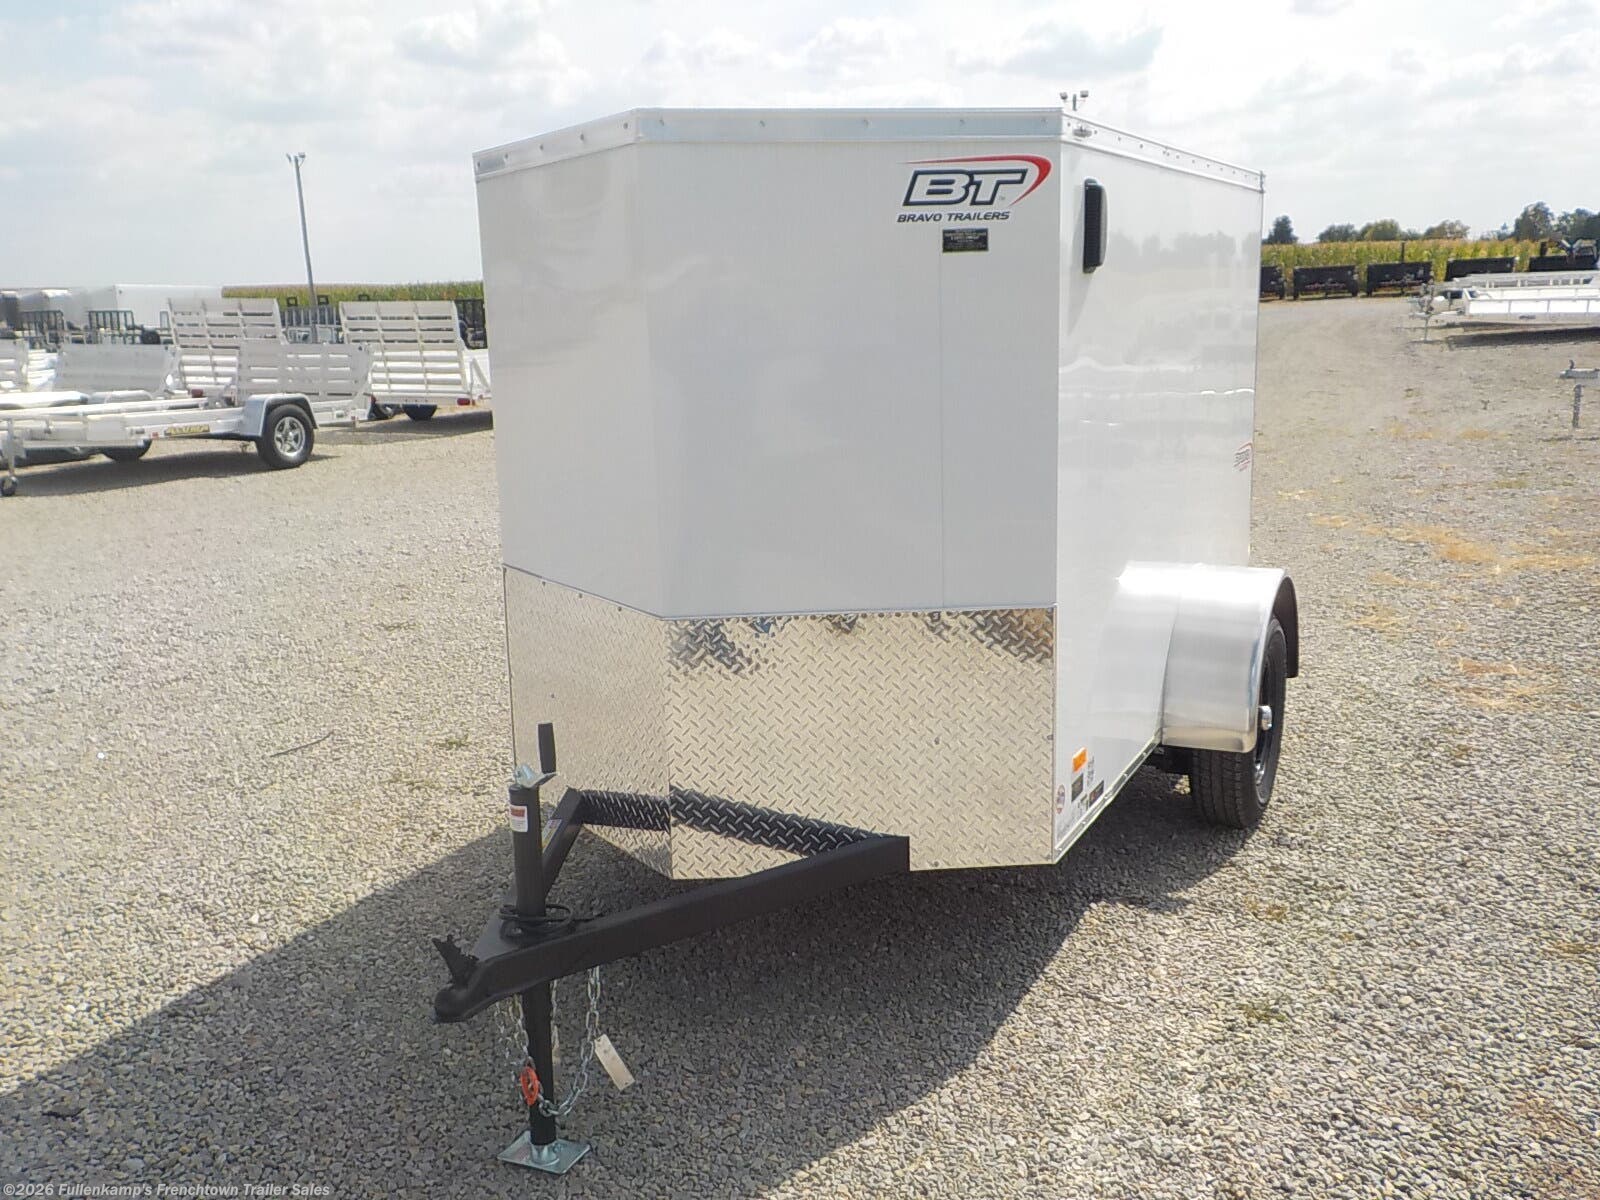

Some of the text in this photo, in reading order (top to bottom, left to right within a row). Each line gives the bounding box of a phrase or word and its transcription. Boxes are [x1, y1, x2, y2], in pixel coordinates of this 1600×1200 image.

[902, 168, 1028, 206] BT
[897, 211, 1011, 223] BRAVO TRAILERS
